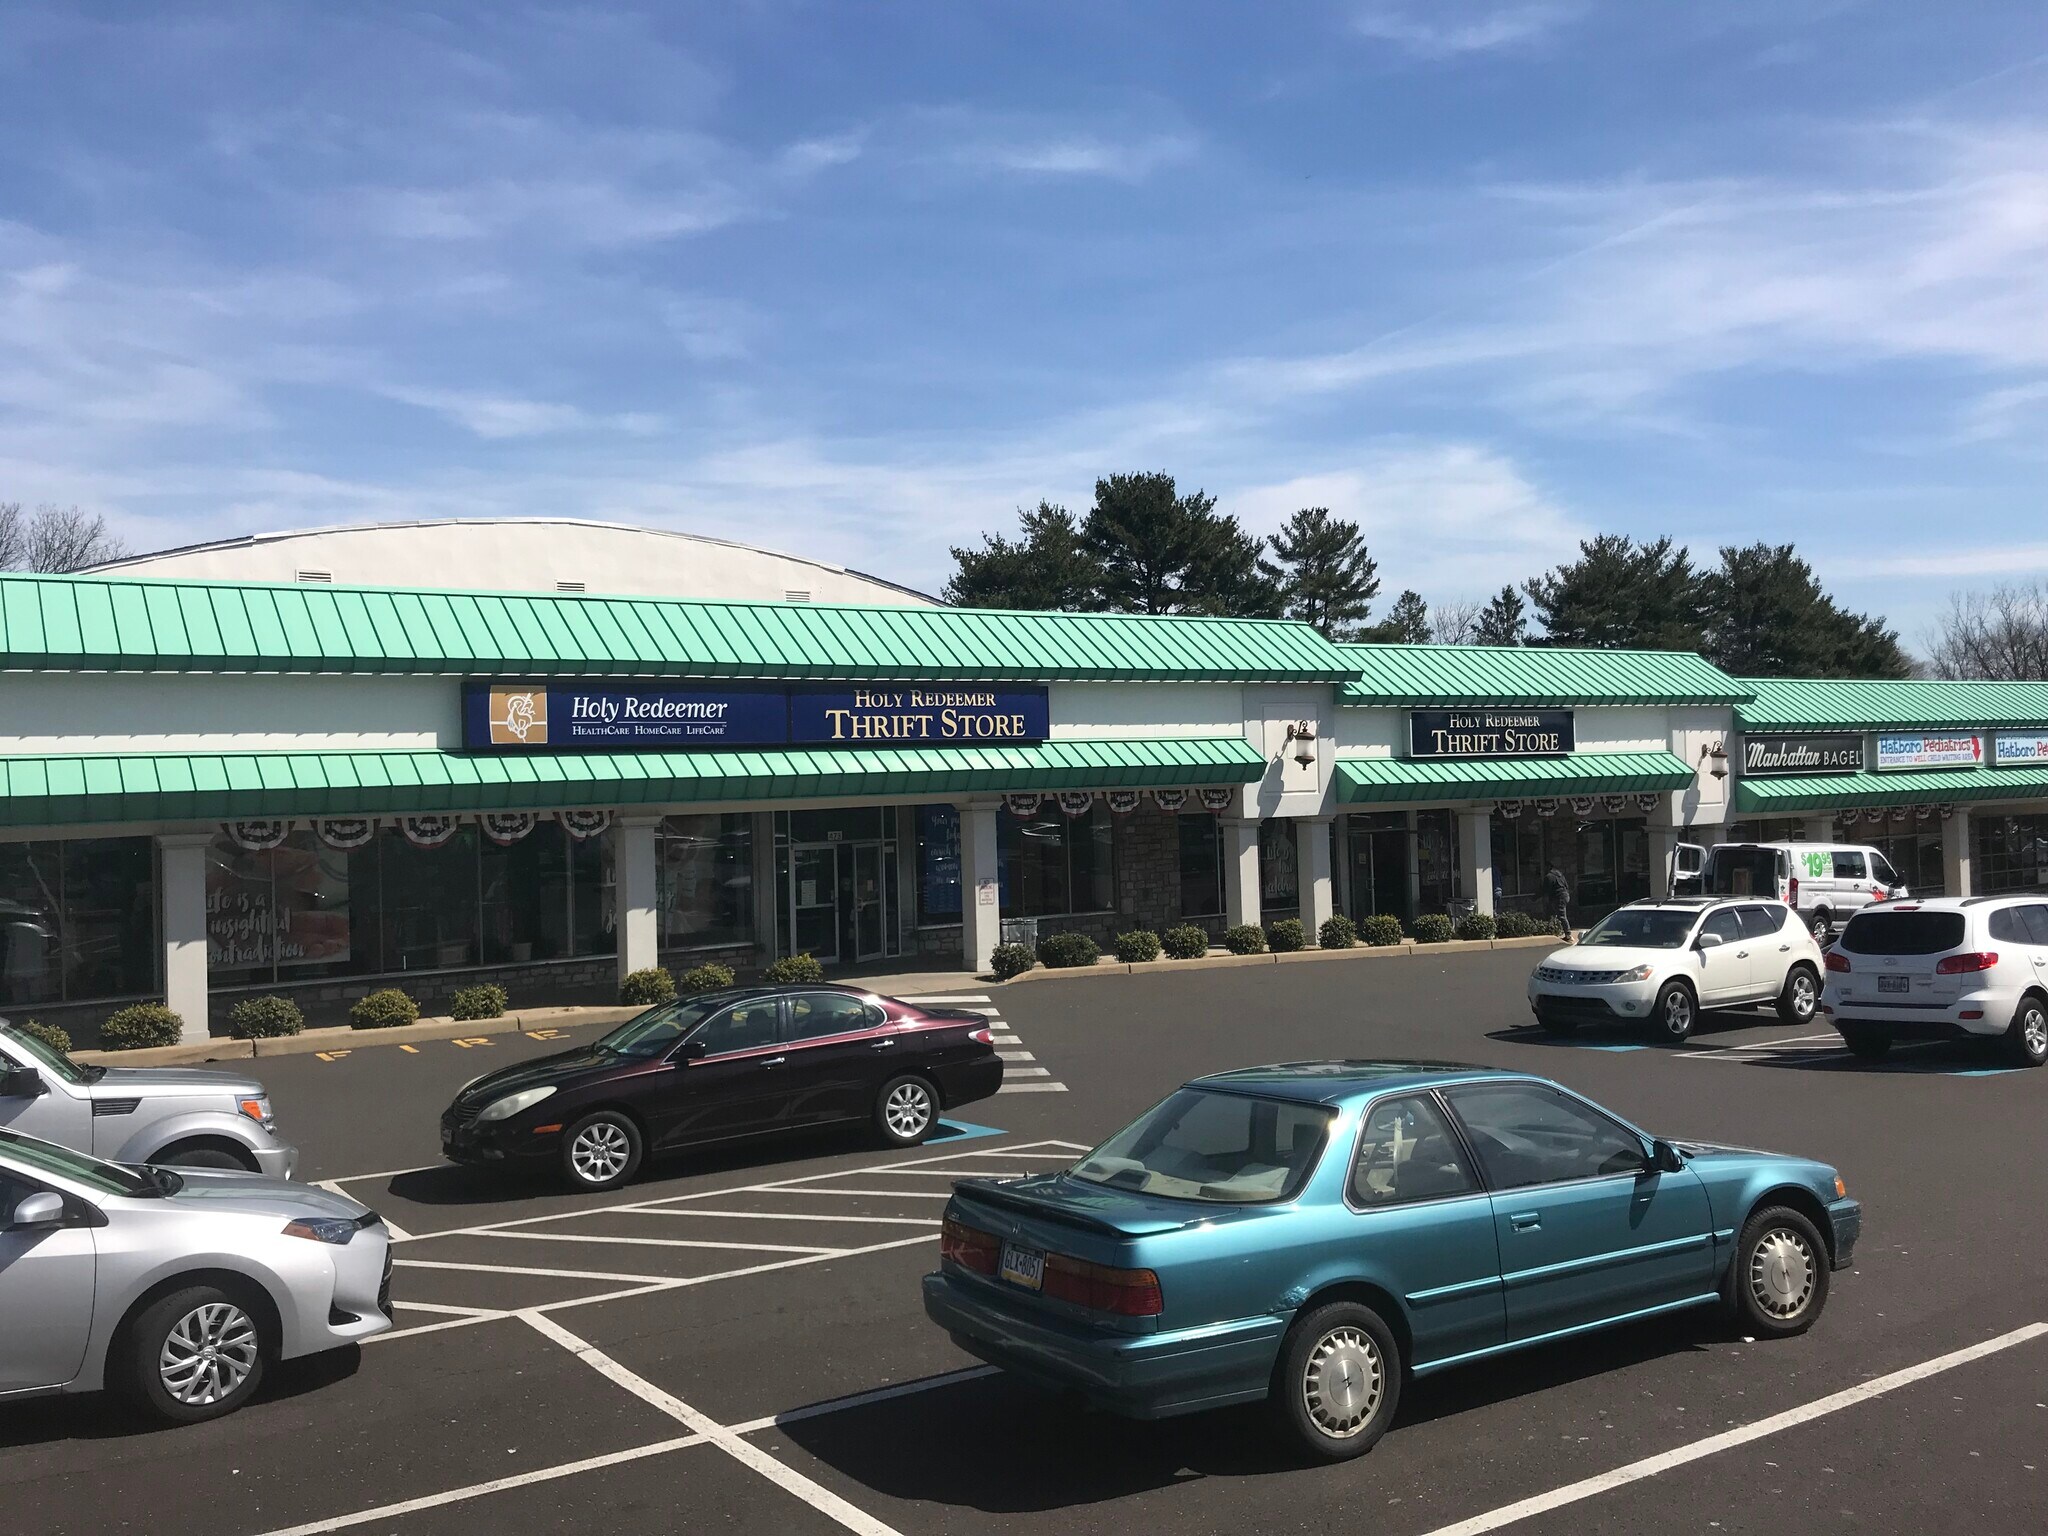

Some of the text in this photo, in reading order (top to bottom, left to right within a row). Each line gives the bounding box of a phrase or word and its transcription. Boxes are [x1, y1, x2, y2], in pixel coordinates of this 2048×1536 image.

[854, 689, 996, 708] HOLY REDEEMER
[572, 697, 728, 722] Holy Redeemer
[572, 725, 630, 735] HEALTHCARE
[634, 725, 682, 735] HOMECARE
[825, 709, 1026, 739] THRIFT STORE
[1449, 713, 1541, 728] HOLY REDEEMER
[1431, 728, 1560, 753] THRIFT STORE
[1879, 736, 1971, 755] Hatboro Pediatrics
[1997, 741, 2036, 758] Hatboro
[1747, 742, 1860, 768] Manhattan BAGEL
[1879, 756, 1905, 764] ENTRANCE
[237, 892, 249, 912] is
[209, 933, 306, 965] ontradiction
[315, 1029, 571, 1062] FIRE
